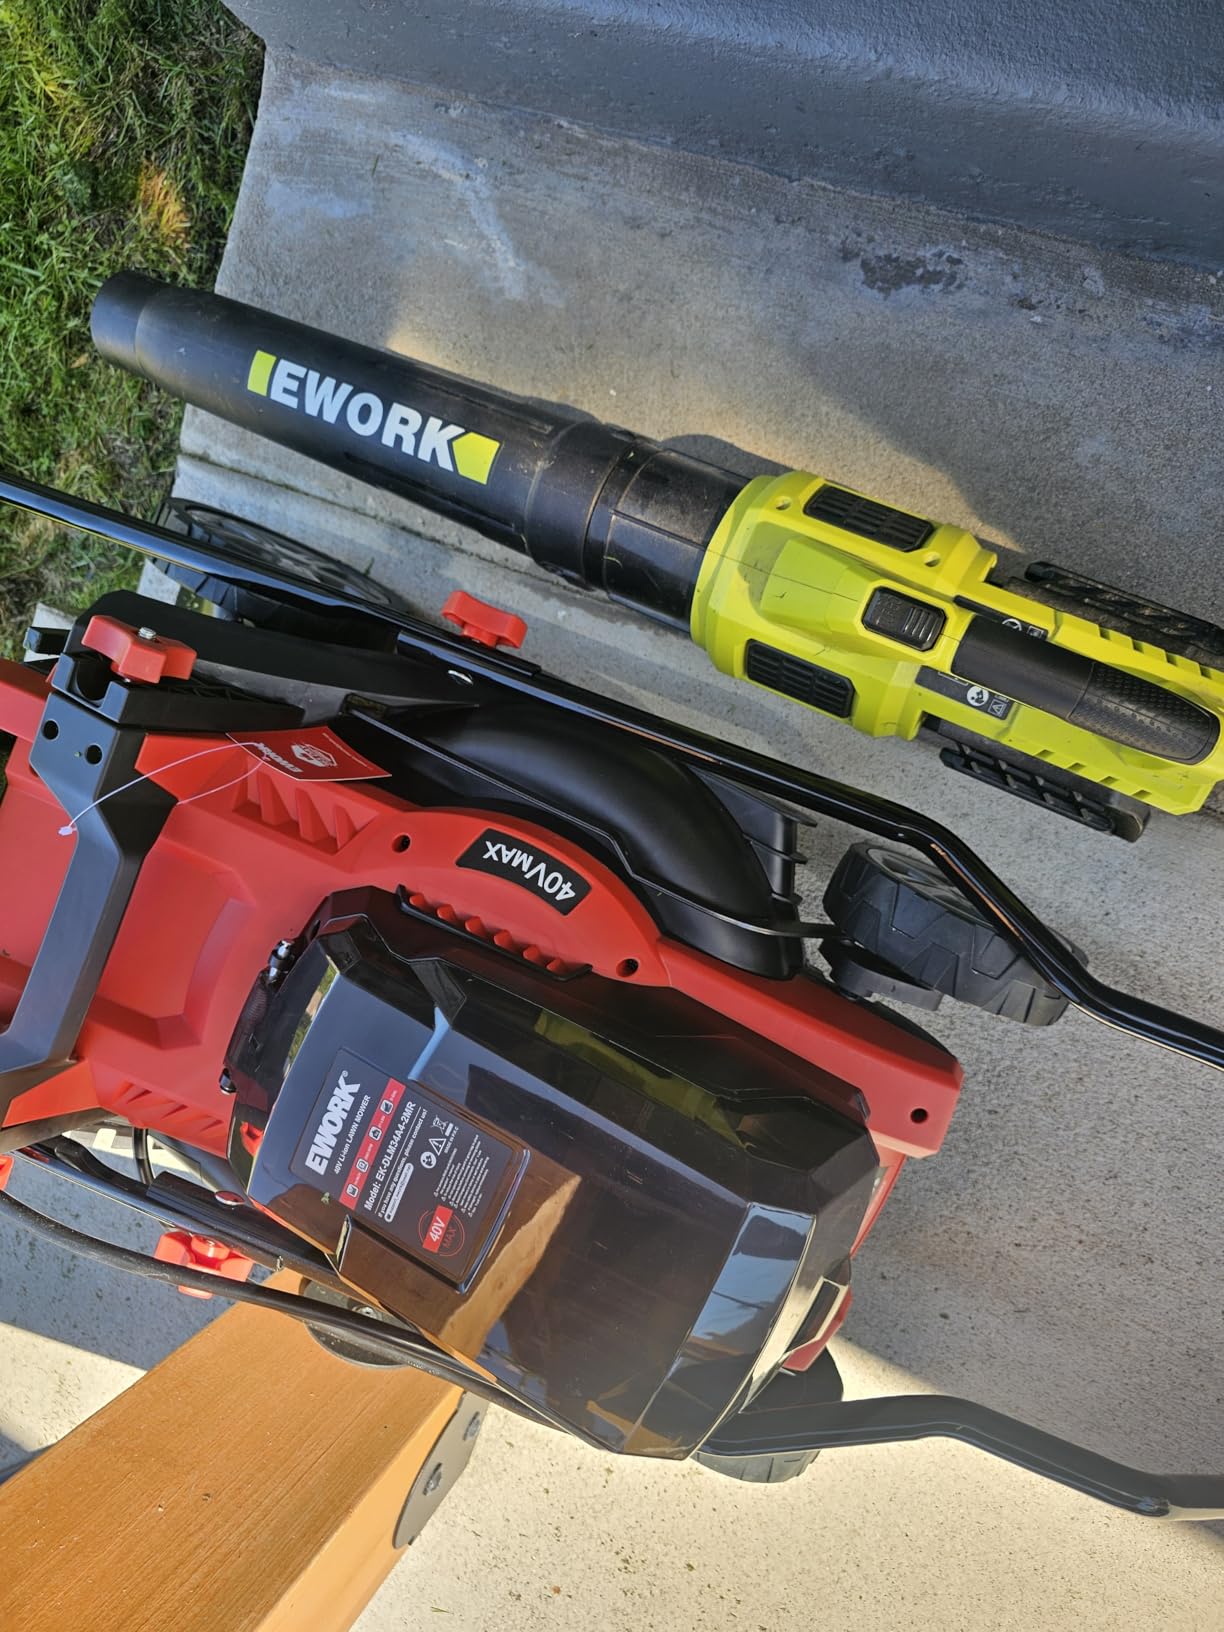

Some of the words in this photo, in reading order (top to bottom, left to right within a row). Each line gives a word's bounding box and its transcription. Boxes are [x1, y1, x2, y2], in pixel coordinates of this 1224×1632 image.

[269, 358, 466, 472] EWORK
[333, 1160, 343, 1174] 40V
[345, 1121, 359, 1143] LAWN
[354, 1093, 371, 1123] MOWER
[363, 1180, 381, 1210] Model:
[375, 1099, 416, 1182] EK-DLM34A4-2MR
[379, 1203, 387, 1213] you
[411, 1117, 423, 1139] contact
[428, 1215, 445, 1243] 40V
[441, 1225, 457, 1249] MAX
